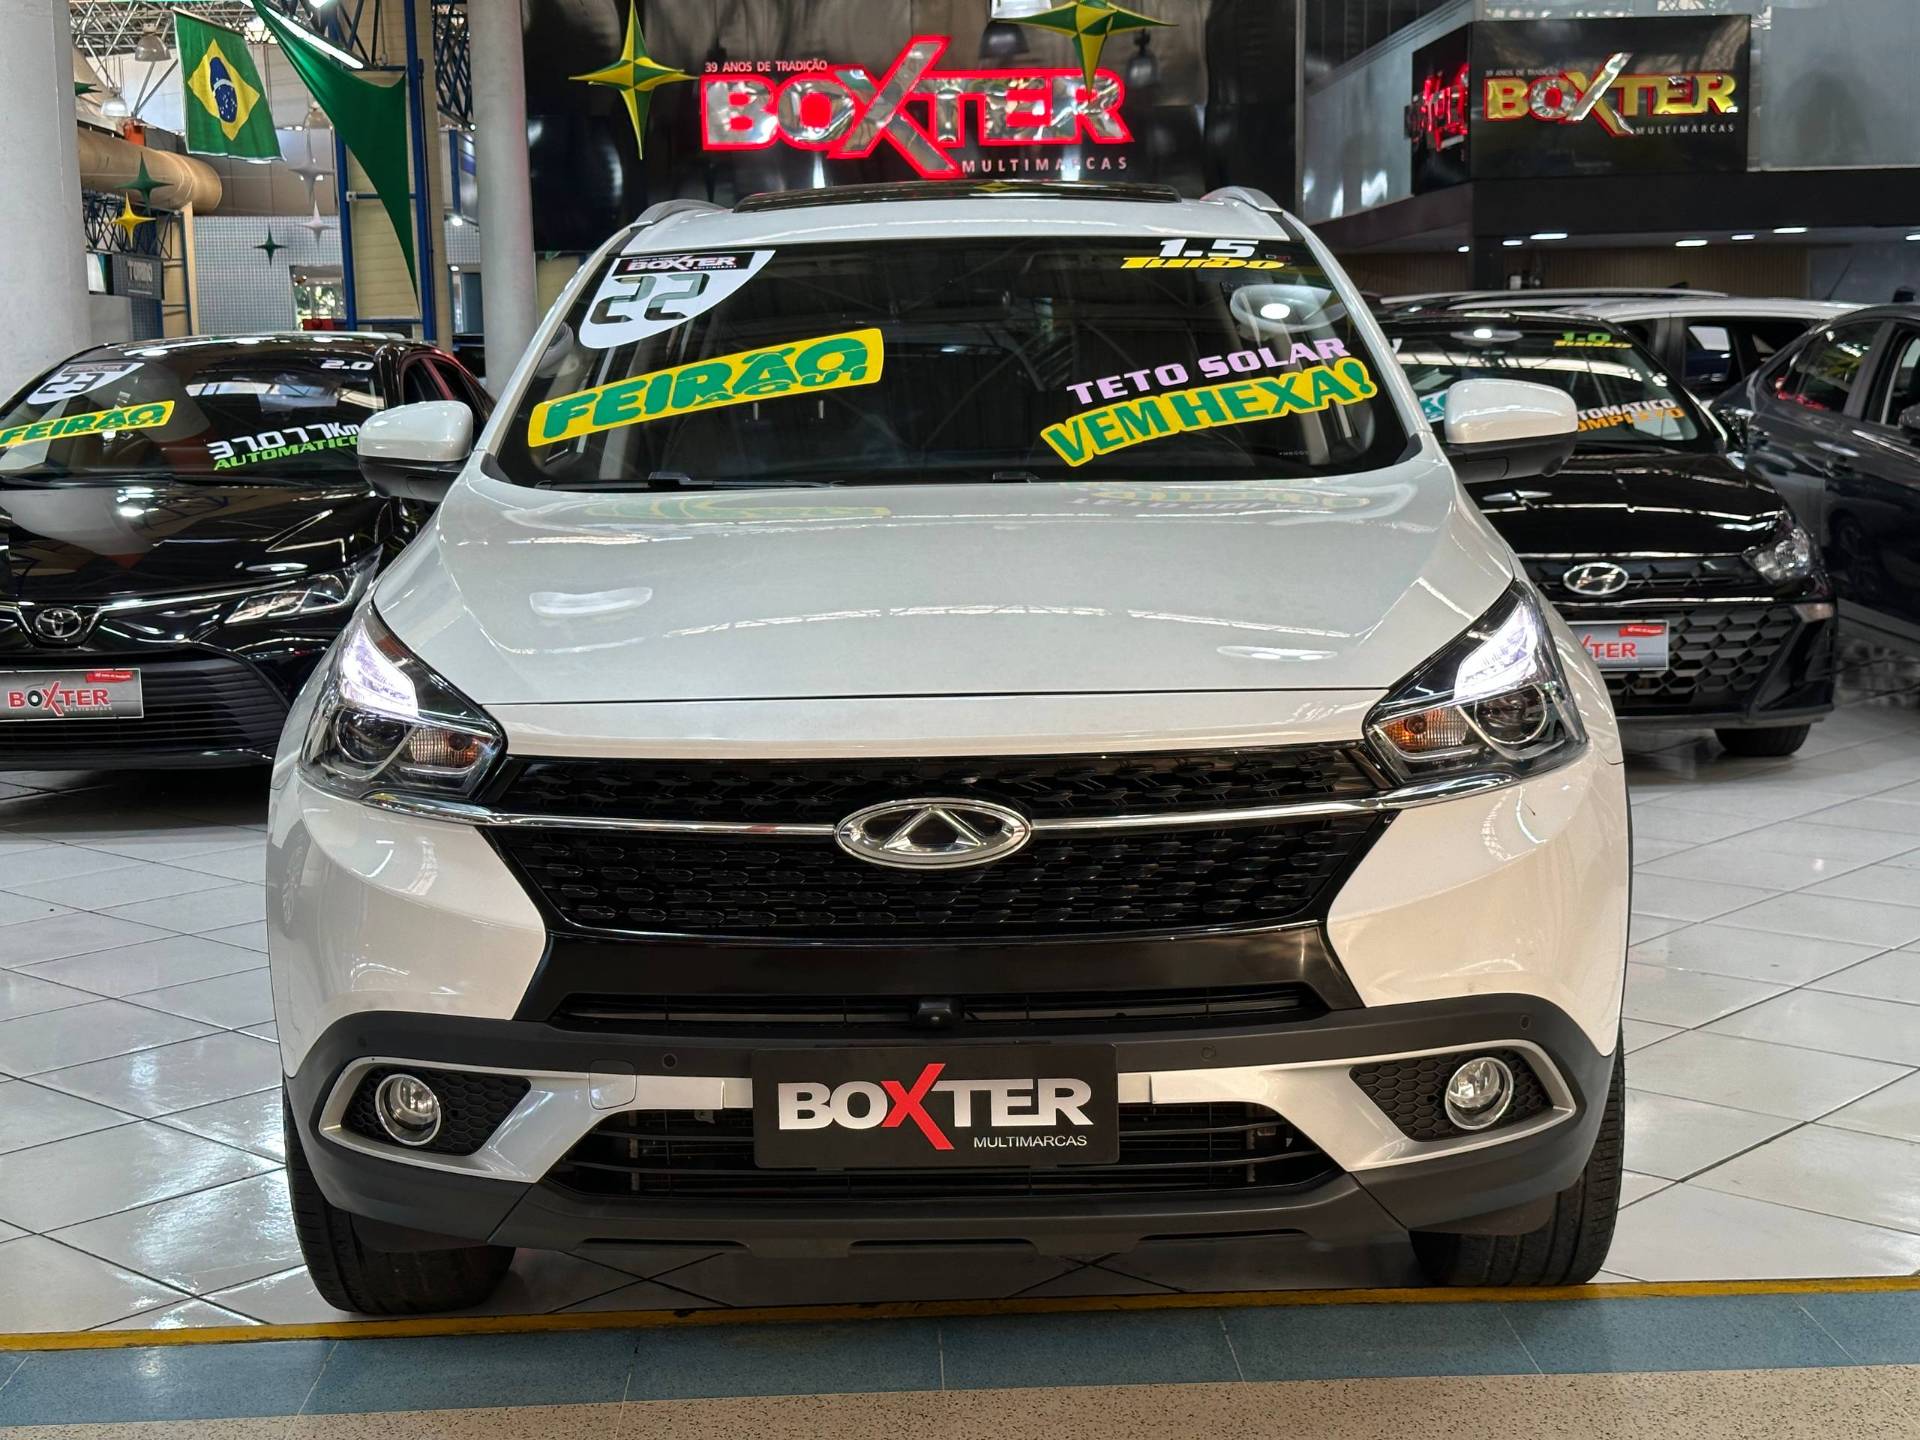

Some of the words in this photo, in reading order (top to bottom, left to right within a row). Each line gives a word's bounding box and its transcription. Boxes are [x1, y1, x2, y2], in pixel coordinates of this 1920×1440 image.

[704, 62, 718, 73] 39
[723, 61, 752, 72] ANOS
[757, 61, 771, 72] DE
[776, 58, 828, 73] TRADIÇÃO
[702, 35, 1135, 178] BOXTER
[1484, 52, 1739, 137] BOXTER
[1636, 123, 1735, 135] MULTIMARCAS
[627, 254, 736, 271] BOXTER
[1159, 238, 1259, 258] 1.5
[590, 273, 710, 325] 22
[320, 359, 375, 371] 2.0
[1066, 363, 1189, 405] TETO
[1198, 337, 1351, 379] SOLAR
[543, 337, 868, 439] FEIRÃO
[0, 404, 166, 447] FEIRÃO
[1047, 398, 1171, 463] VEM
[1168, 361, 1373, 429] HEXA!
[8, 681, 112, 716] BOXTER
[778, 1063, 1094, 1150] BOXTER
[974, 1135, 1088, 1148] MULTIMARCAS
